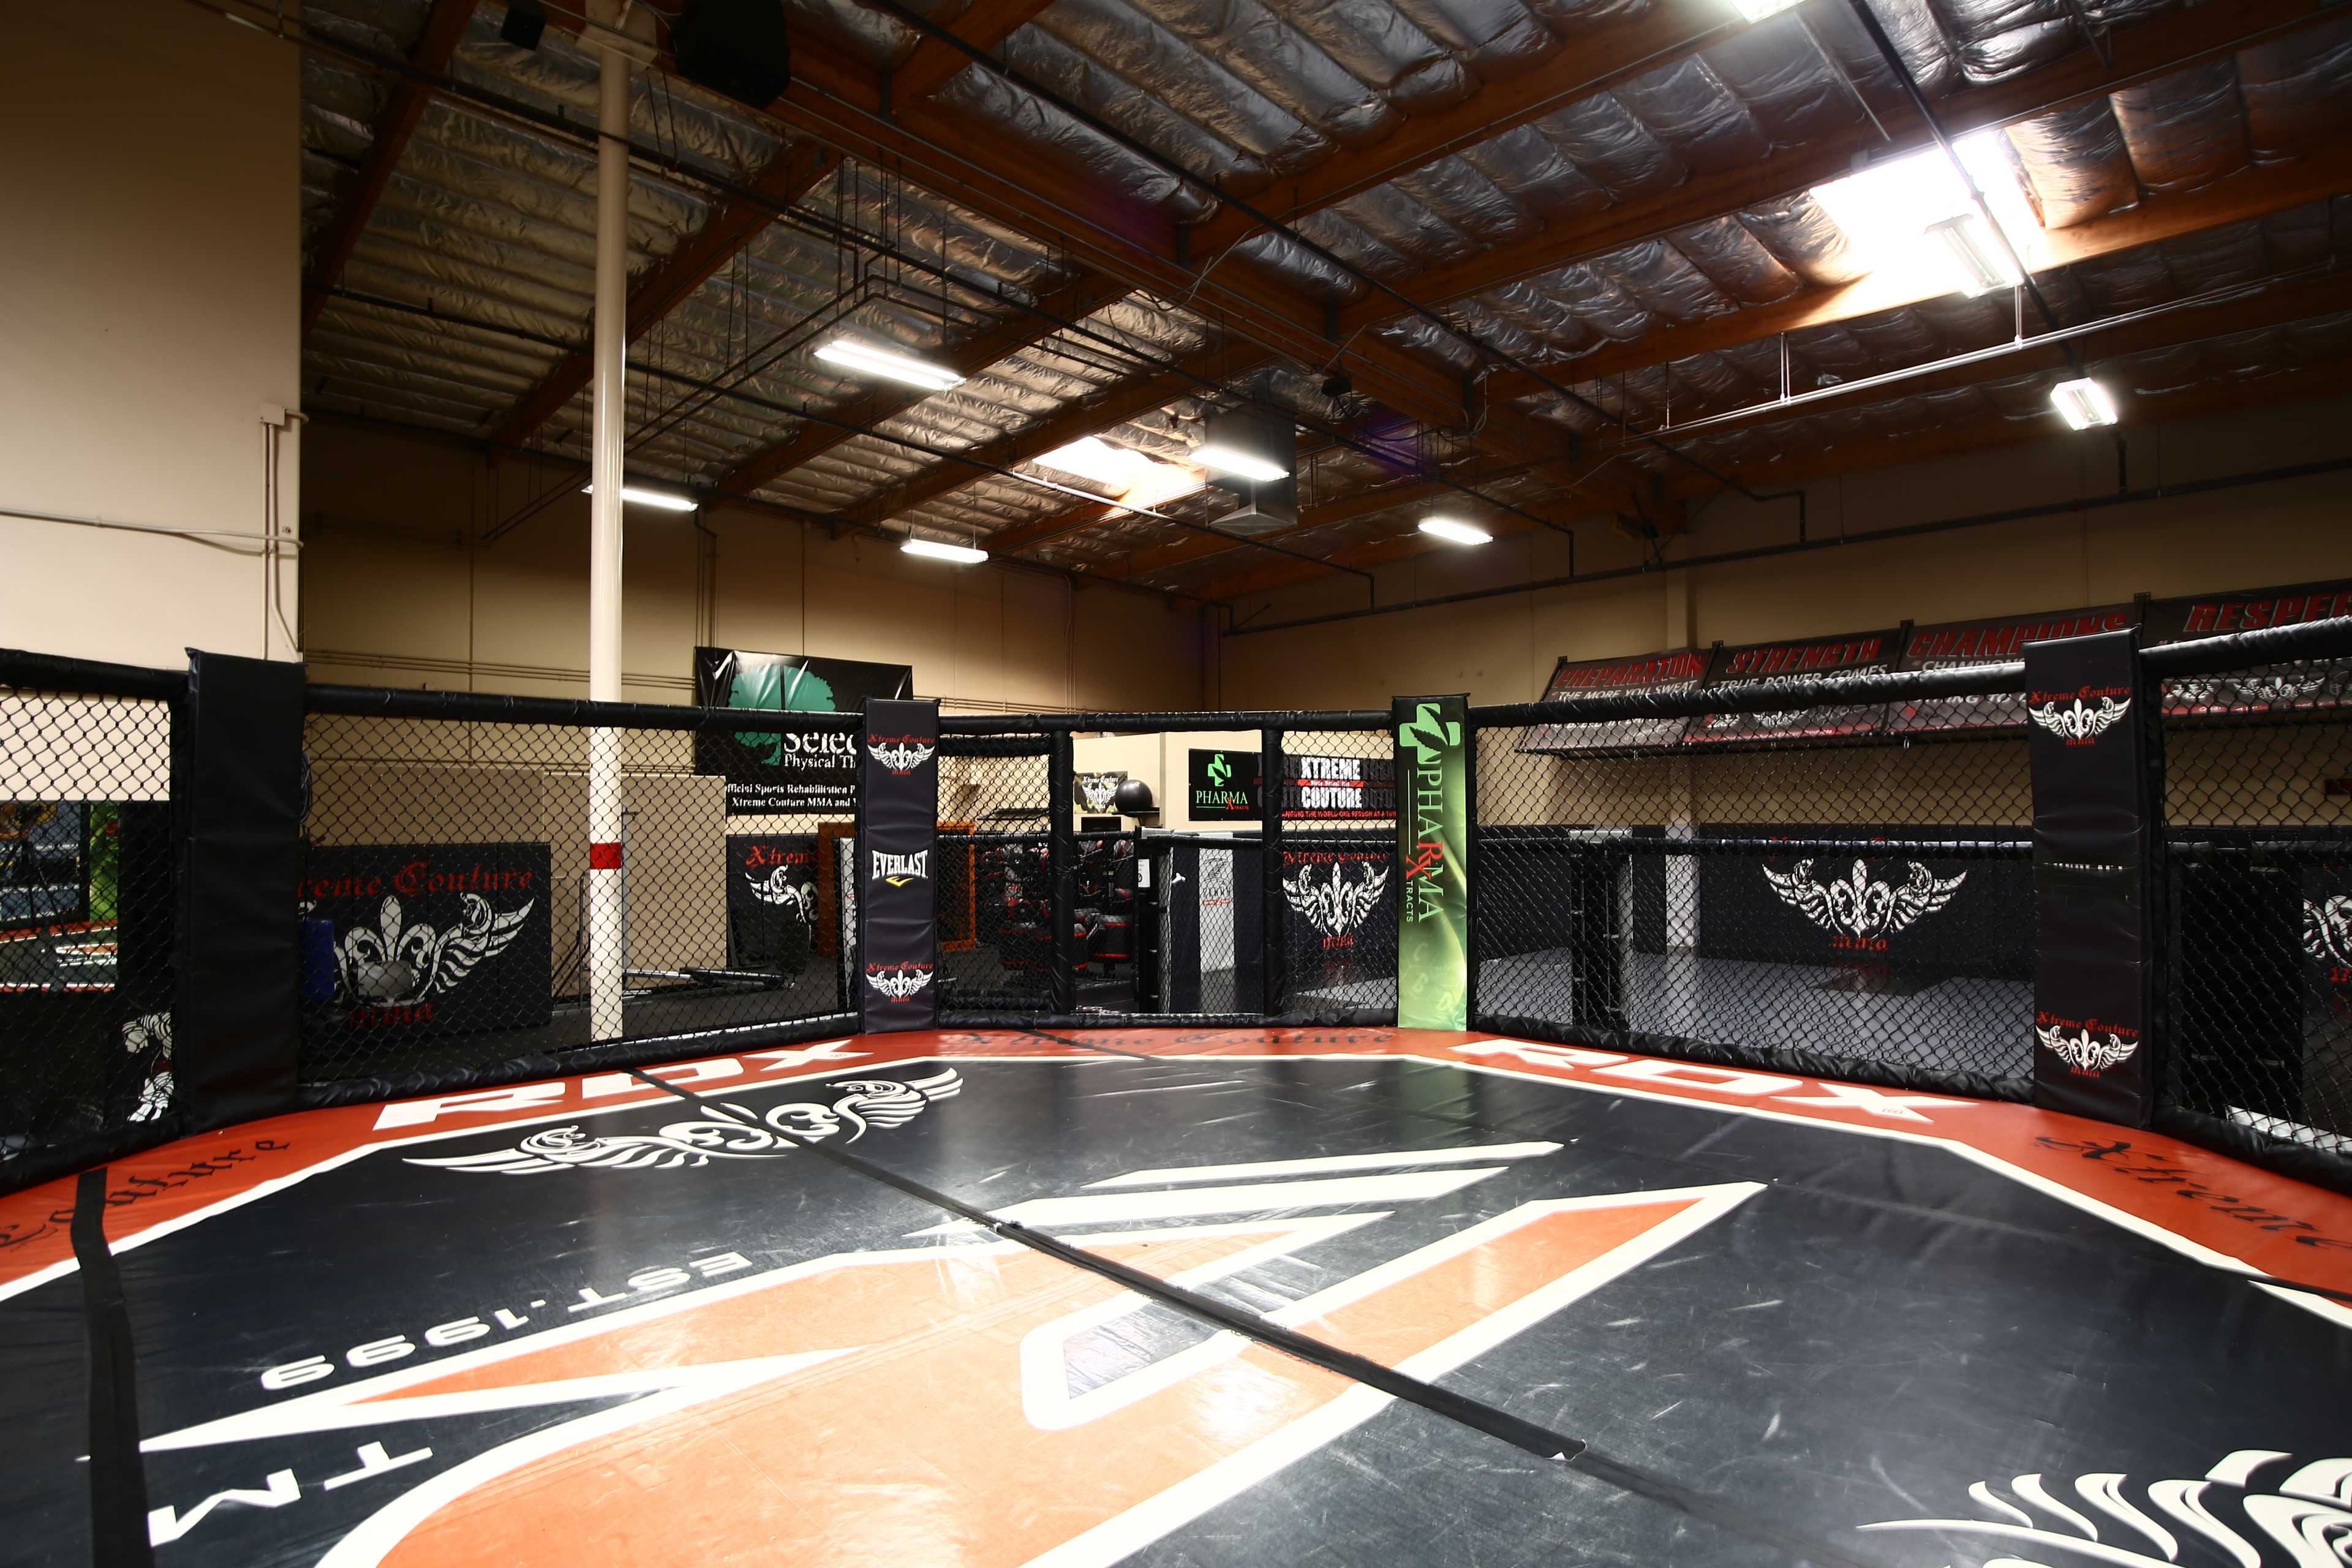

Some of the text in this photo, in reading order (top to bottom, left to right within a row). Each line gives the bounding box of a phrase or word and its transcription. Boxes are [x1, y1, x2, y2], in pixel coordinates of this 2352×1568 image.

[1726, 638, 1882, 674] STRENGTH
[1553, 653, 1705, 688] PREPARATION
[1656, 680, 1697, 695] SWEAT
[2029, 691, 2076, 704] Xtreme
[2078, 685, 2131, 698] Couture
[869, 734, 935, 744] Xtreme Couture
[785, 753, 835, 770] Physical
[1301, 756, 1360, 780] XTREME
[755, 784, 784, 795] Sports
[1196, 790, 1248, 804] PHARMA
[1301, 786, 1362, 809] COUTURE
[732, 797, 766, 807] Xtreme
[768, 797, 805, 807] Couture
[807, 797, 832, 807] MMA
[835, 797, 850, 807] and
[1417, 767, 1444, 922] PHARMA
[872, 850, 929, 879] EVERLAST
[394, 862, 533, 895] Couture
[1833, 935, 1888, 951] mma
[866, 961, 933, 973] Xtreme Couture
[2037, 1011, 2138, 1037] Xtreme Couture
[1446, 1038, 1980, 1122] RDX
[2070, 1066, 2100, 1079] mma
[373, 1039, 875, 1131] RDX
